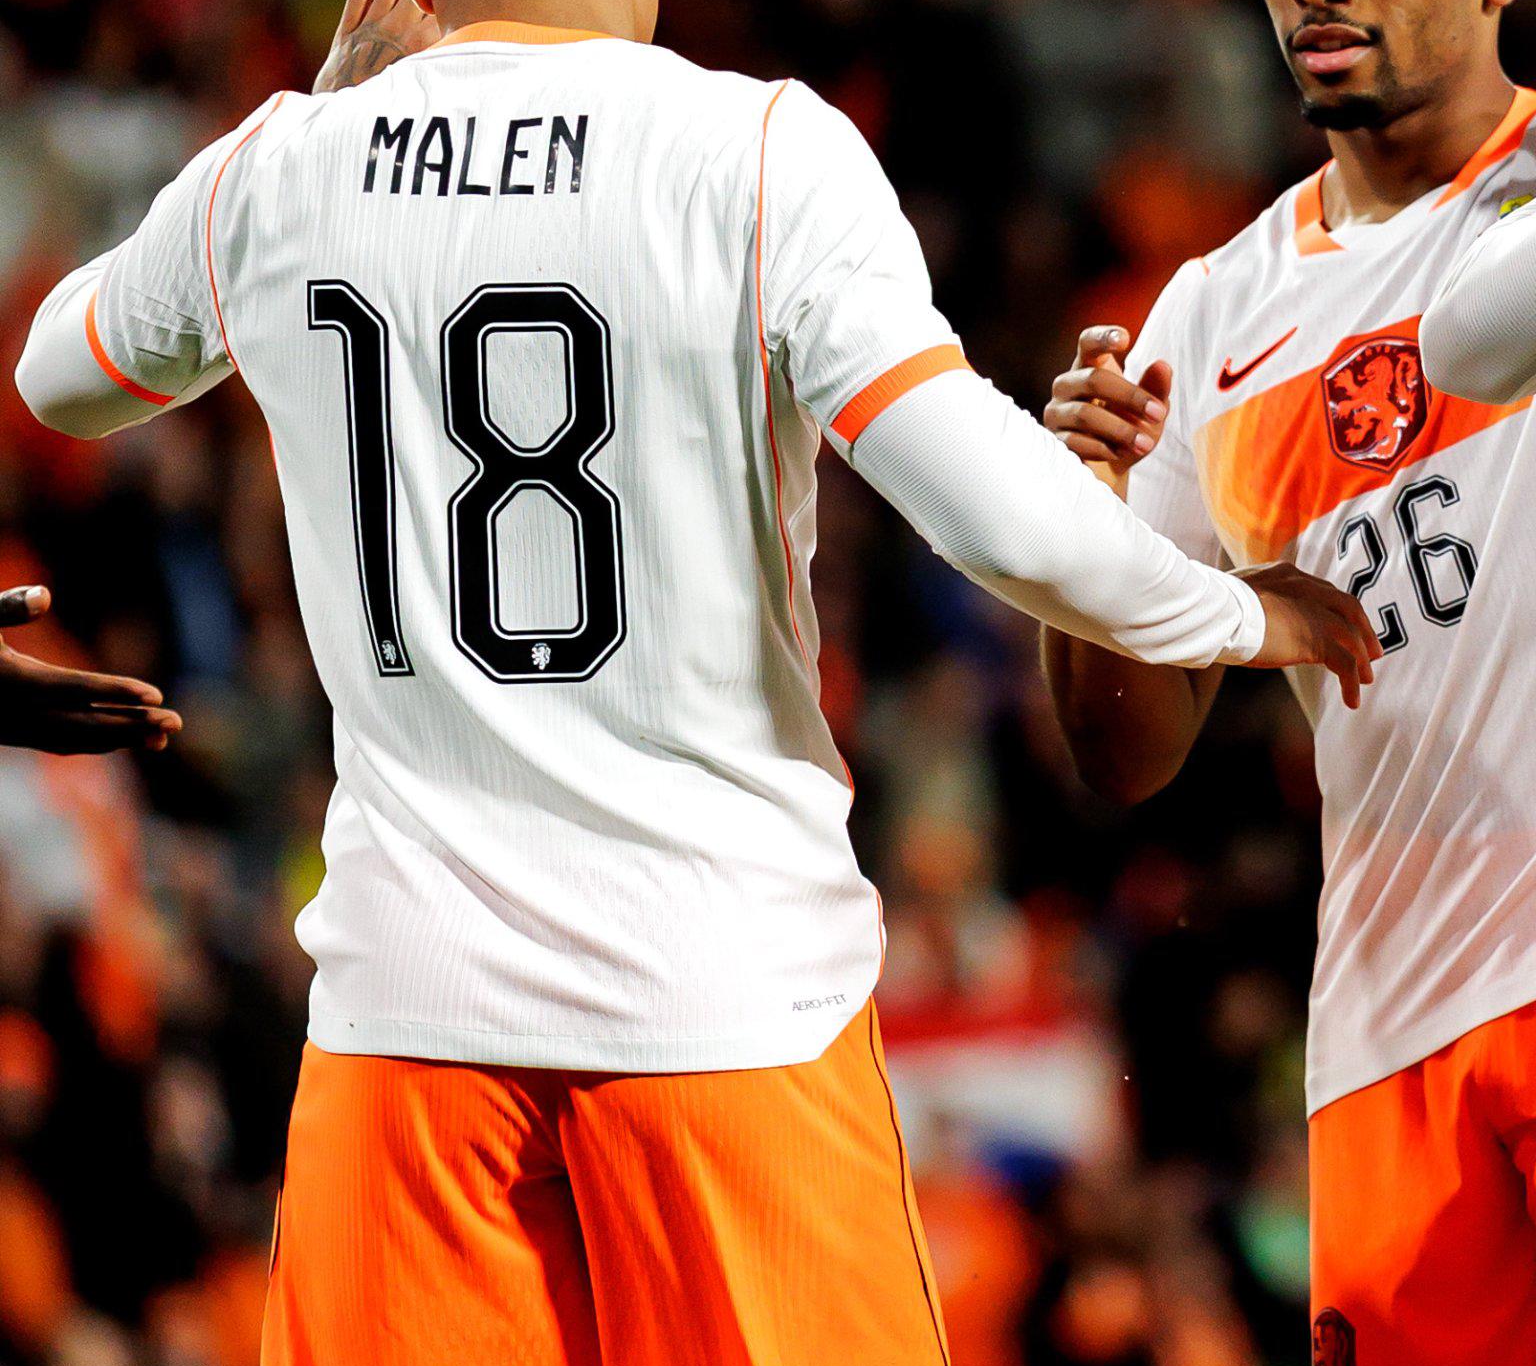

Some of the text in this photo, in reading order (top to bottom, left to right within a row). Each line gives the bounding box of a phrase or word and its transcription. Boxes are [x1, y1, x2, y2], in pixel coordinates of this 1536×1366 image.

[362, 114, 589, 197] MALEN
[307, 279, 628, 685] 18
[1337, 474, 1480, 654] 26
